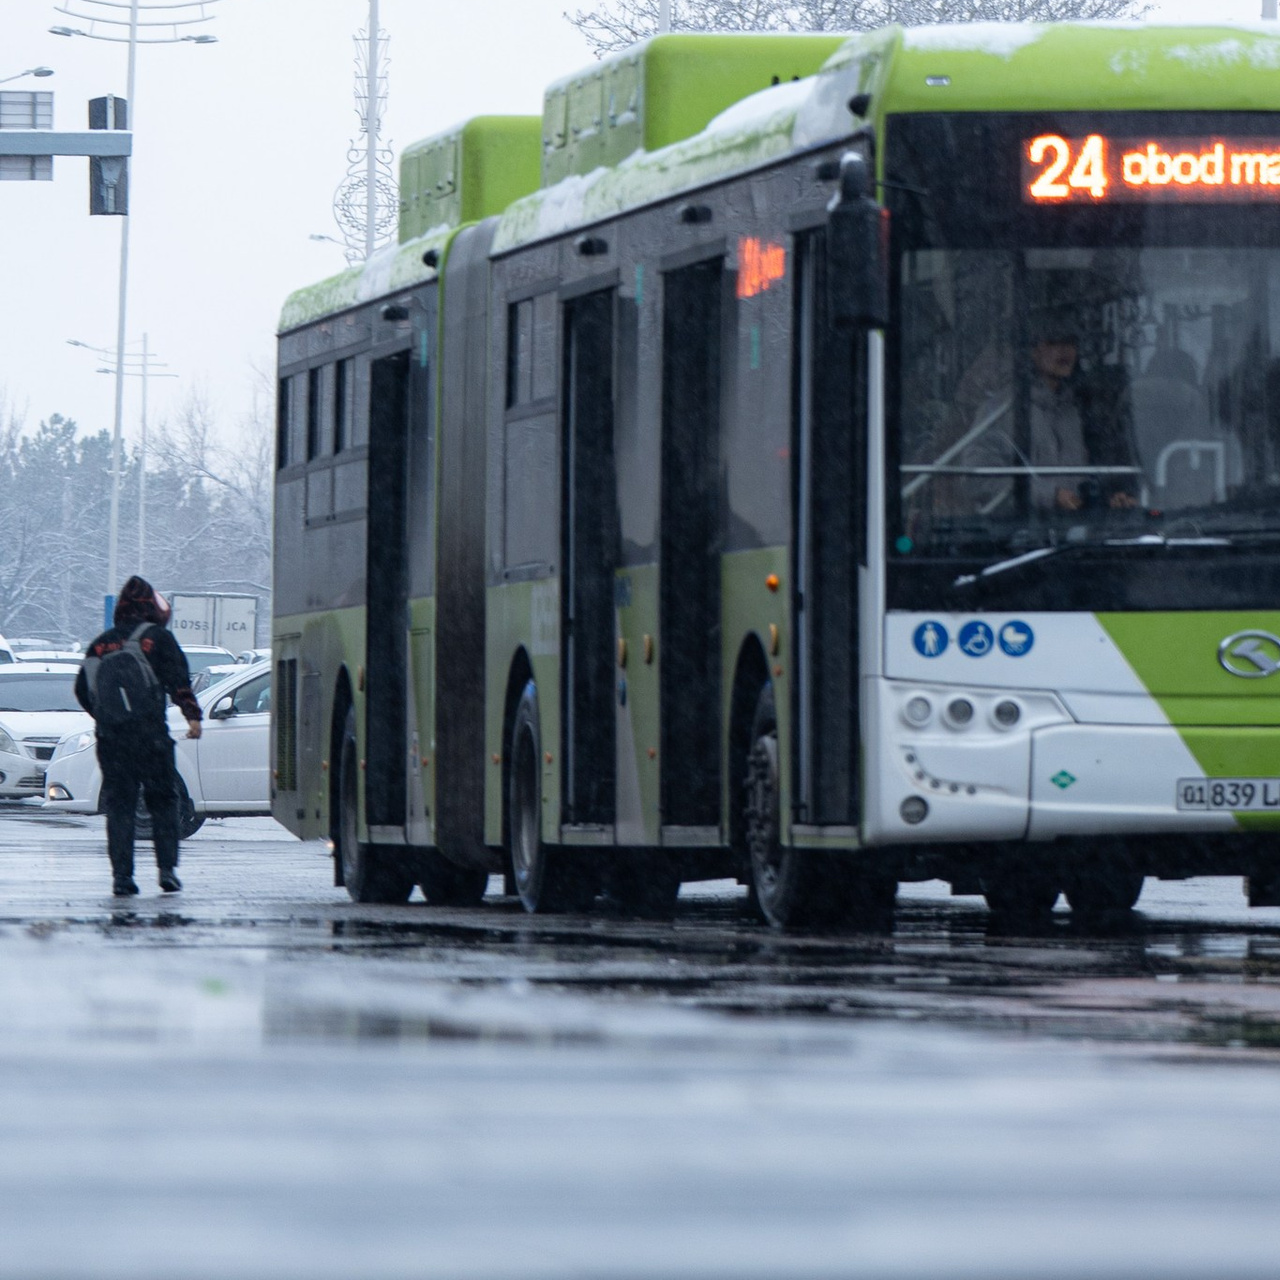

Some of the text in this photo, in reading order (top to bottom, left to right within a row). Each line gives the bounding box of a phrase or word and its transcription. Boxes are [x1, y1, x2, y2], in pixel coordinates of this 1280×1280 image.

[1028, 135, 1107, 199] 24
[1121, 142, 1225, 186] obod
[225, 621, 247, 632] JCA
[1211, 782, 1256, 807] 839
